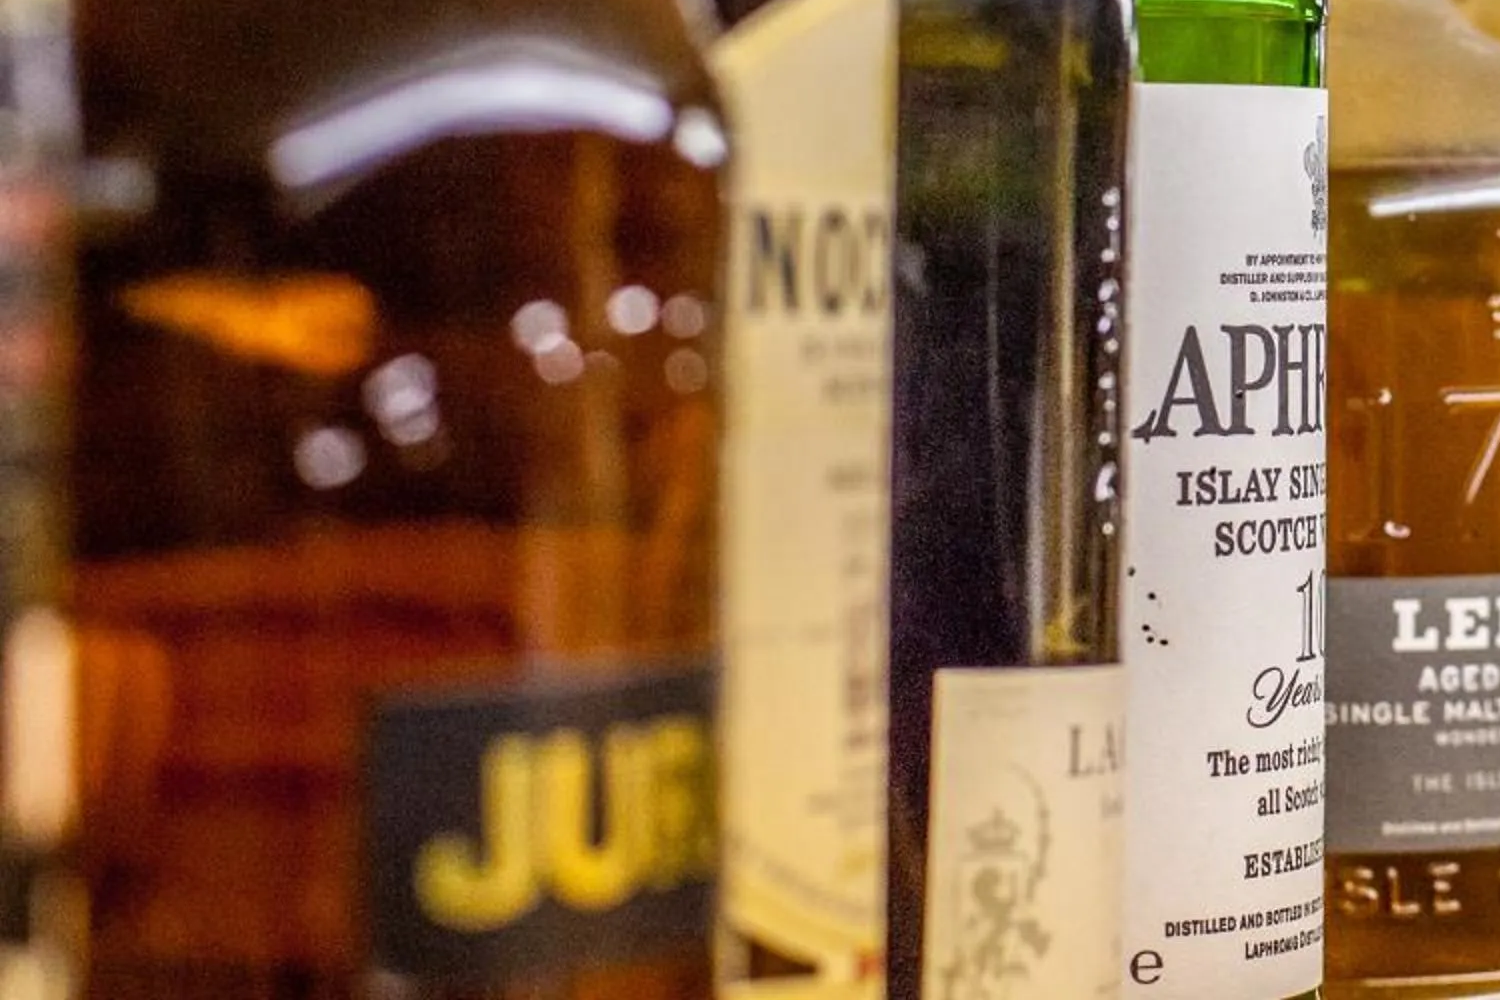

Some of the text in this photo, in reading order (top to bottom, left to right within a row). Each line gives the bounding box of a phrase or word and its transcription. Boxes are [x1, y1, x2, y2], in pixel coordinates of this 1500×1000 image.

[1220, 273, 1268, 285] DISTILLER
[1176, 467, 1282, 506] ISLAY
[1215, 514, 1317, 558] SCOTCH
[1323, 701, 1432, 727] SINGLE
[1207, 749, 1251, 777] The
[1256, 743, 1295, 773] most
[1412, 772, 1452, 794] THE
[1257, 787, 1281, 816] all
[1164, 915, 1237, 938] DISTILLED
[1239, 910, 1263, 931] AND
[1266, 904, 1302, 926] BOTTLED
[1130, 949, 1164, 985] e
